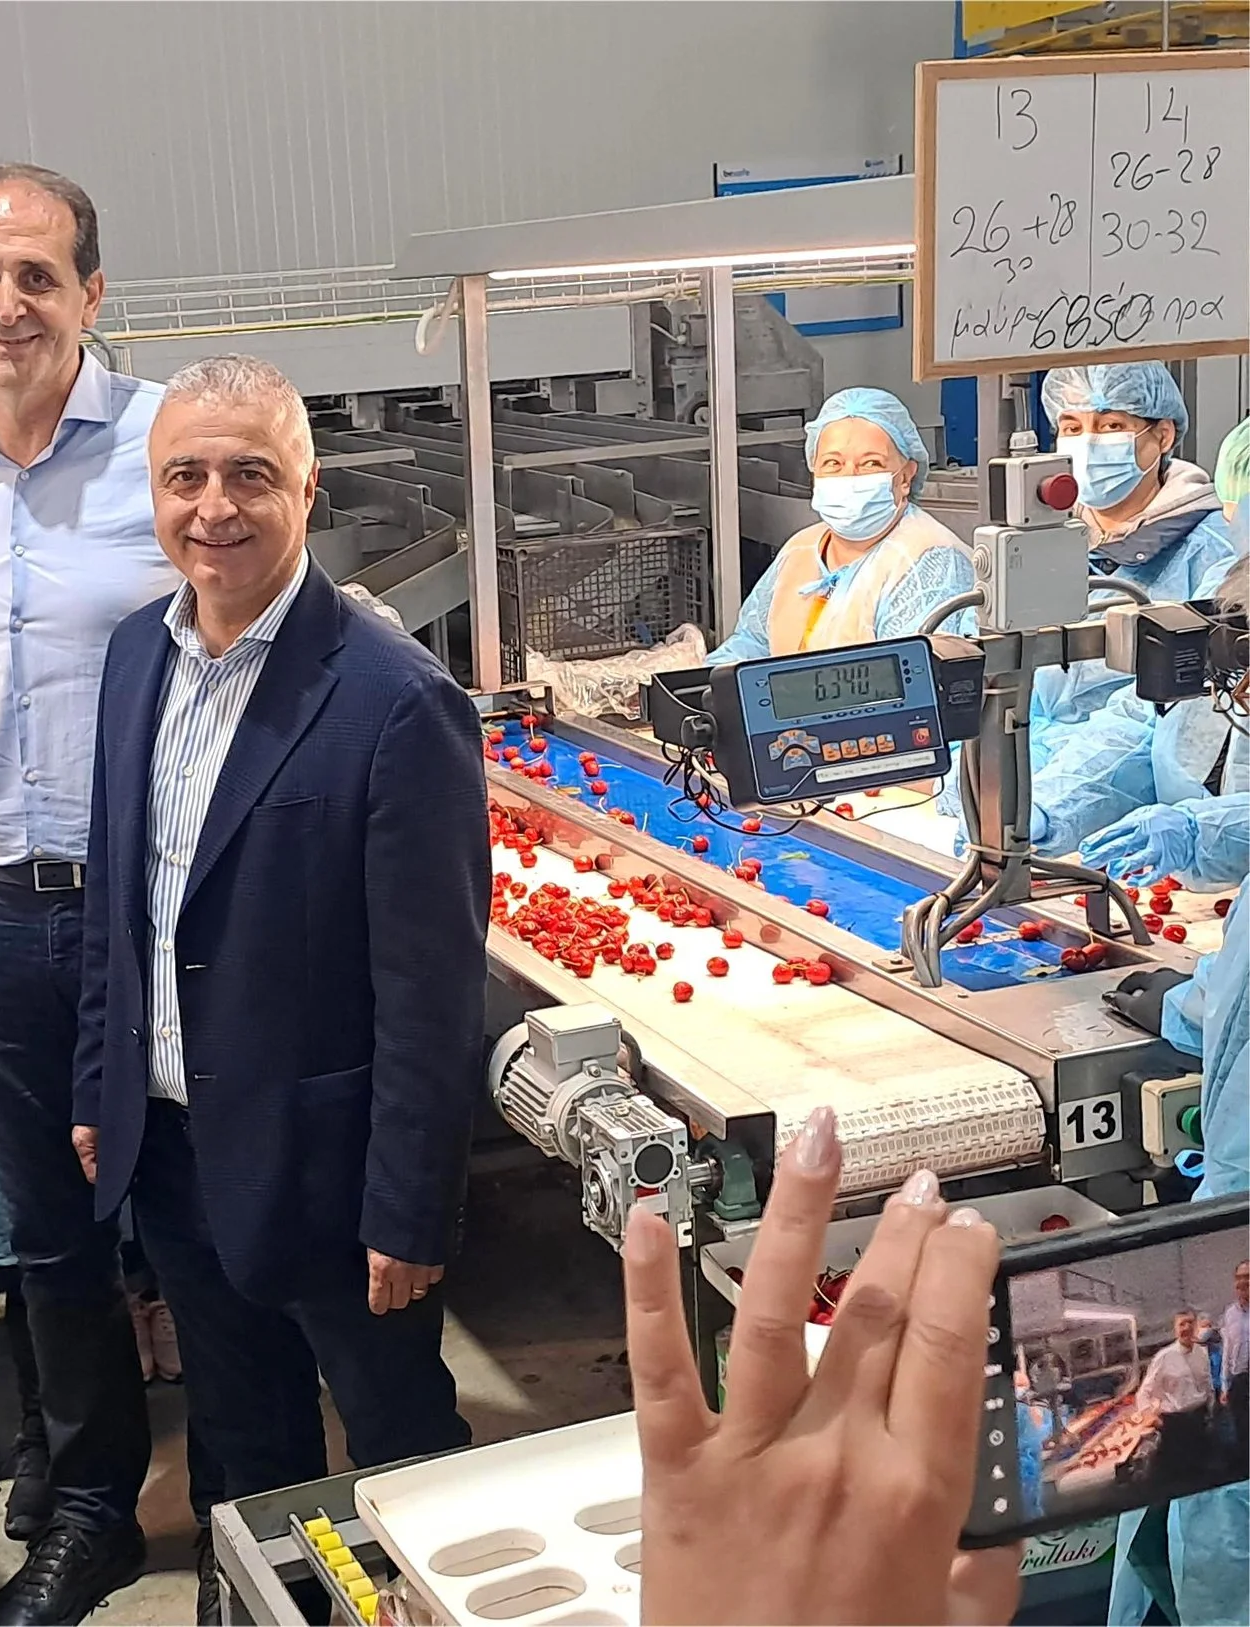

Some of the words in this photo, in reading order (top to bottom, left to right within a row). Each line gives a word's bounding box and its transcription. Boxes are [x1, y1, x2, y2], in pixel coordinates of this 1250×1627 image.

[997, 85, 1038, 150] 13
[1145, 82, 1188, 143] 14
[1066, 1100, 1116, 1144] 13
